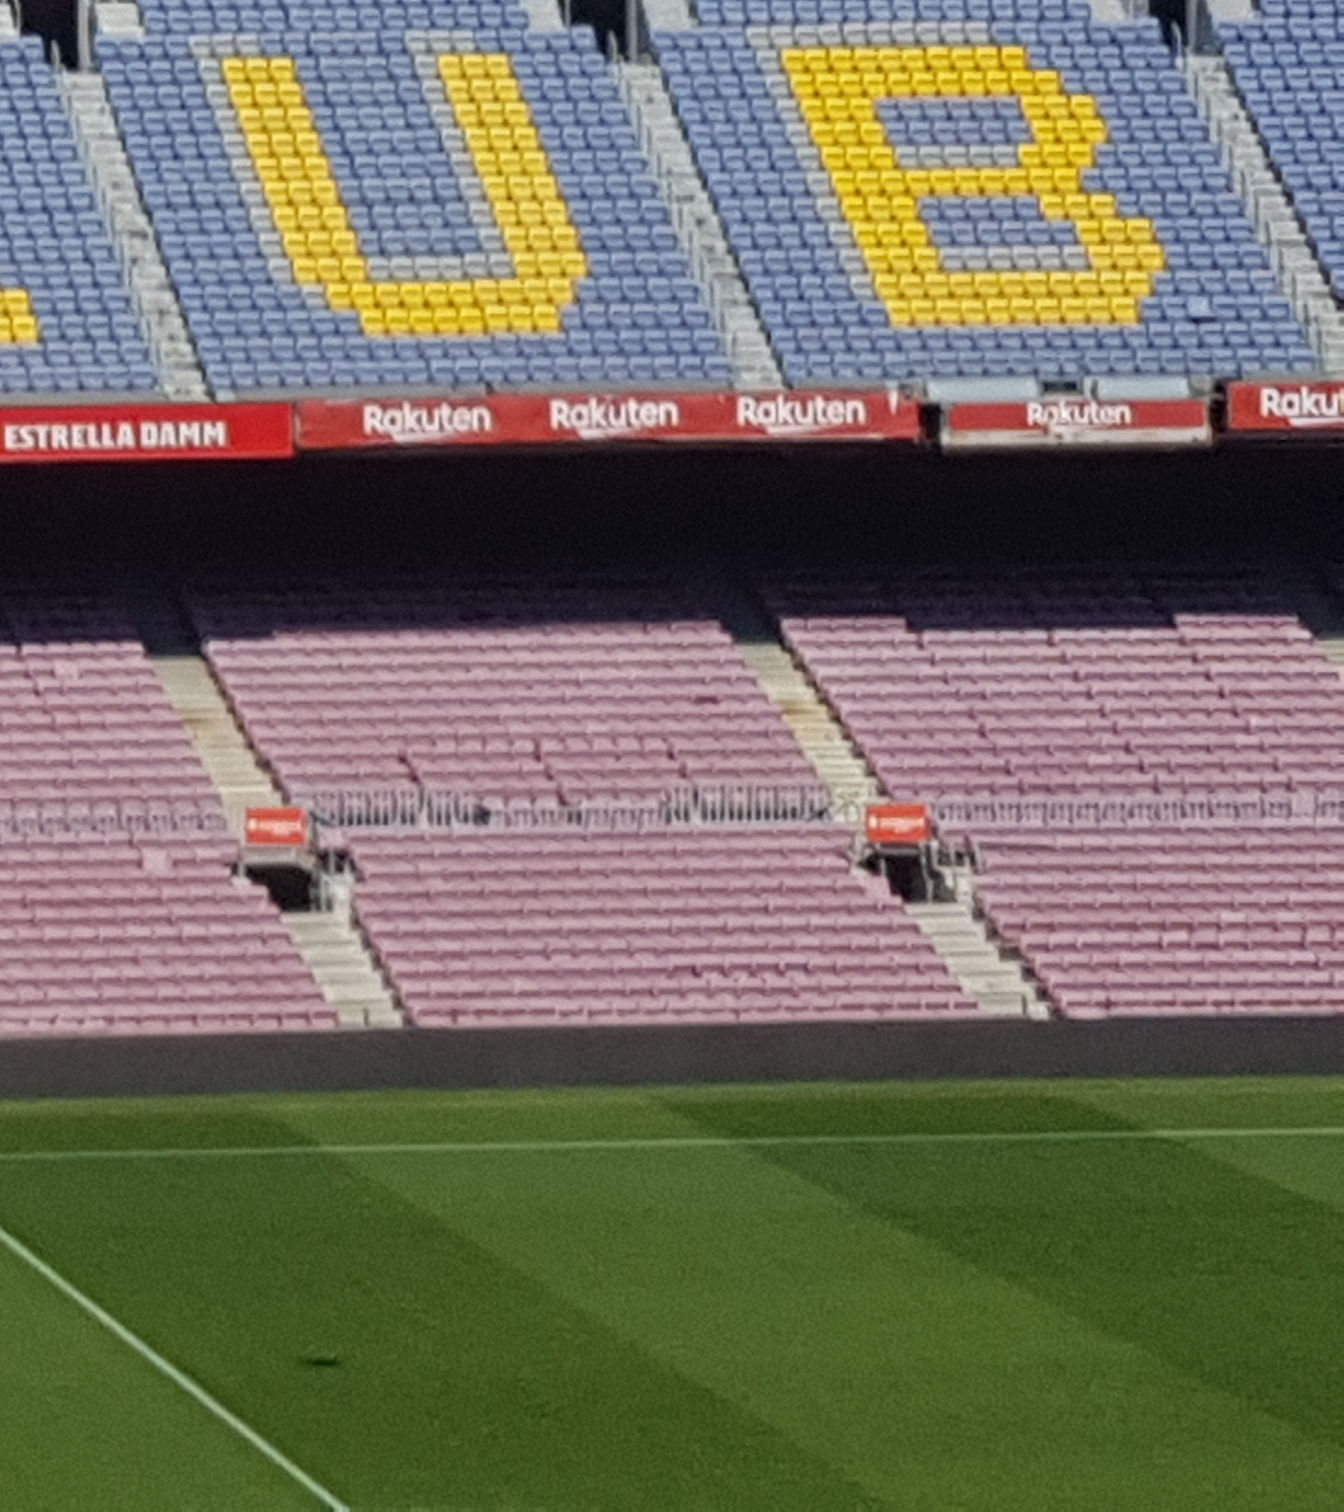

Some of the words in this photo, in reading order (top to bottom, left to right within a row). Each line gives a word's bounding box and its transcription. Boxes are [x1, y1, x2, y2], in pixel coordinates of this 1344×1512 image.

[552, 399, 677, 430] Rakuten
[736, 396, 865, 426] Rakuten
[1026, 401, 1131, 428] Rakuten
[1262, 386, 1344, 418] Raku
[365, 403, 491, 435] Rakuten
[4, 423, 135, 450] ESTRELLA
[139, 421, 226, 447] DAMM
